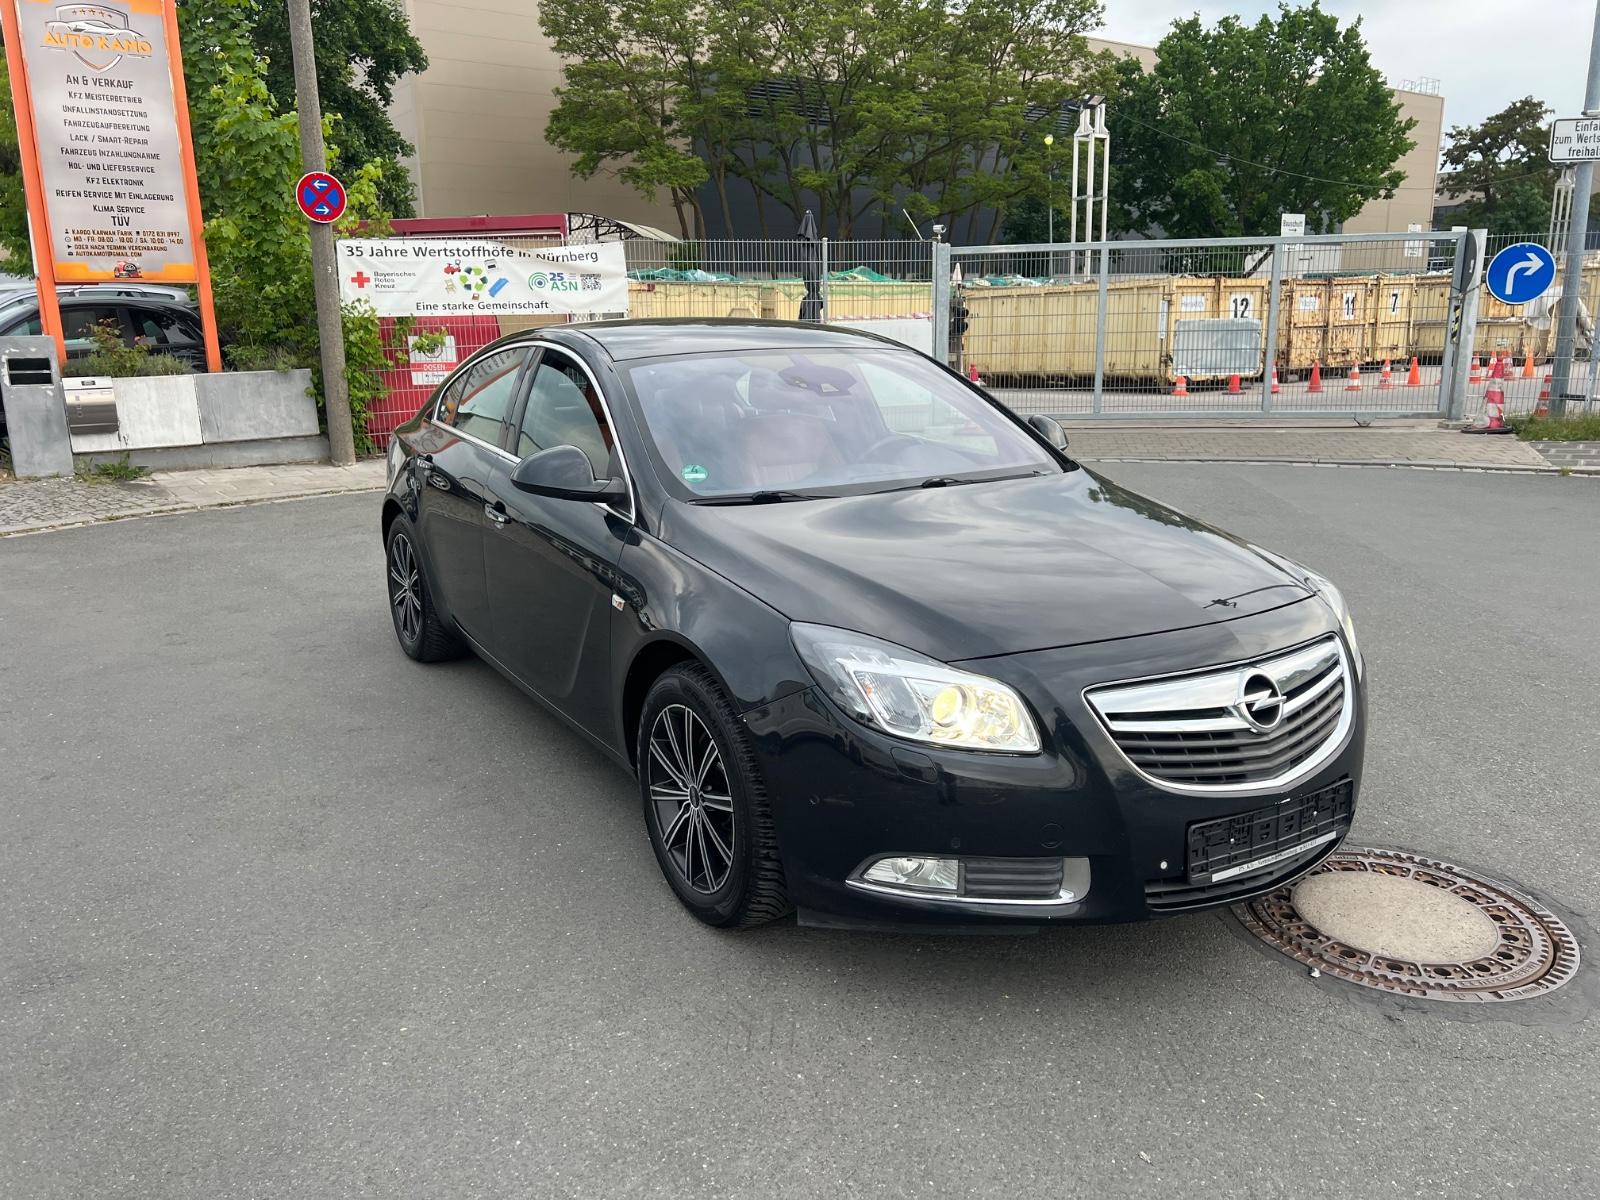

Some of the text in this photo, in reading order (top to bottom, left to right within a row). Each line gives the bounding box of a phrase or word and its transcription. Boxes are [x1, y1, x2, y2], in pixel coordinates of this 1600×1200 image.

[44, 31, 152, 54] AUTO KAMO
[82, 76, 88, 85] &
[92, 77, 134, 89] VERKAUF
[84, 92, 143, 104] MEISTERBETRIEB
[62, 105, 147, 118] UNFALLINSTANDSETZUNG
[63, 119, 150, 132] FAHRZEUGAUFBEREITUNG
[1575, 121, 1600, 132] Einfa
[1554, 136, 1572, 145] zum
[60, 147, 97, 157] FAHRZEUG
[1568, 146, 1600, 157] freihal
[86, 163, 101, 171] UND
[102, 163, 155, 173] LIEFERSERVICE
[102, 177, 144, 186] ELEKTRONIK
[56, 189, 82, 198] REIFEN
[83, 190, 113, 199] SERVICE
[128, 192, 174, 201] EINLAGERUNG
[92, 204, 145, 213] KLIMA SERVICE
[110, 213, 130, 227] TÜV
[346, 246, 364, 257] 35
[369, 246, 408, 257] Jahre
[413, 246, 514, 257] Wertstoffhöfe
[549, 272, 564, 281] 25
[551, 281, 578, 291] ASN
[416, 301, 549, 311] Eine starke Gemeinschaft
[1232, 297, 1249, 318] 12
[1344, 296, 1355, 316] 11
[1391, 293, 1398, 313] 7
[690, 465, 698, 474] 4
